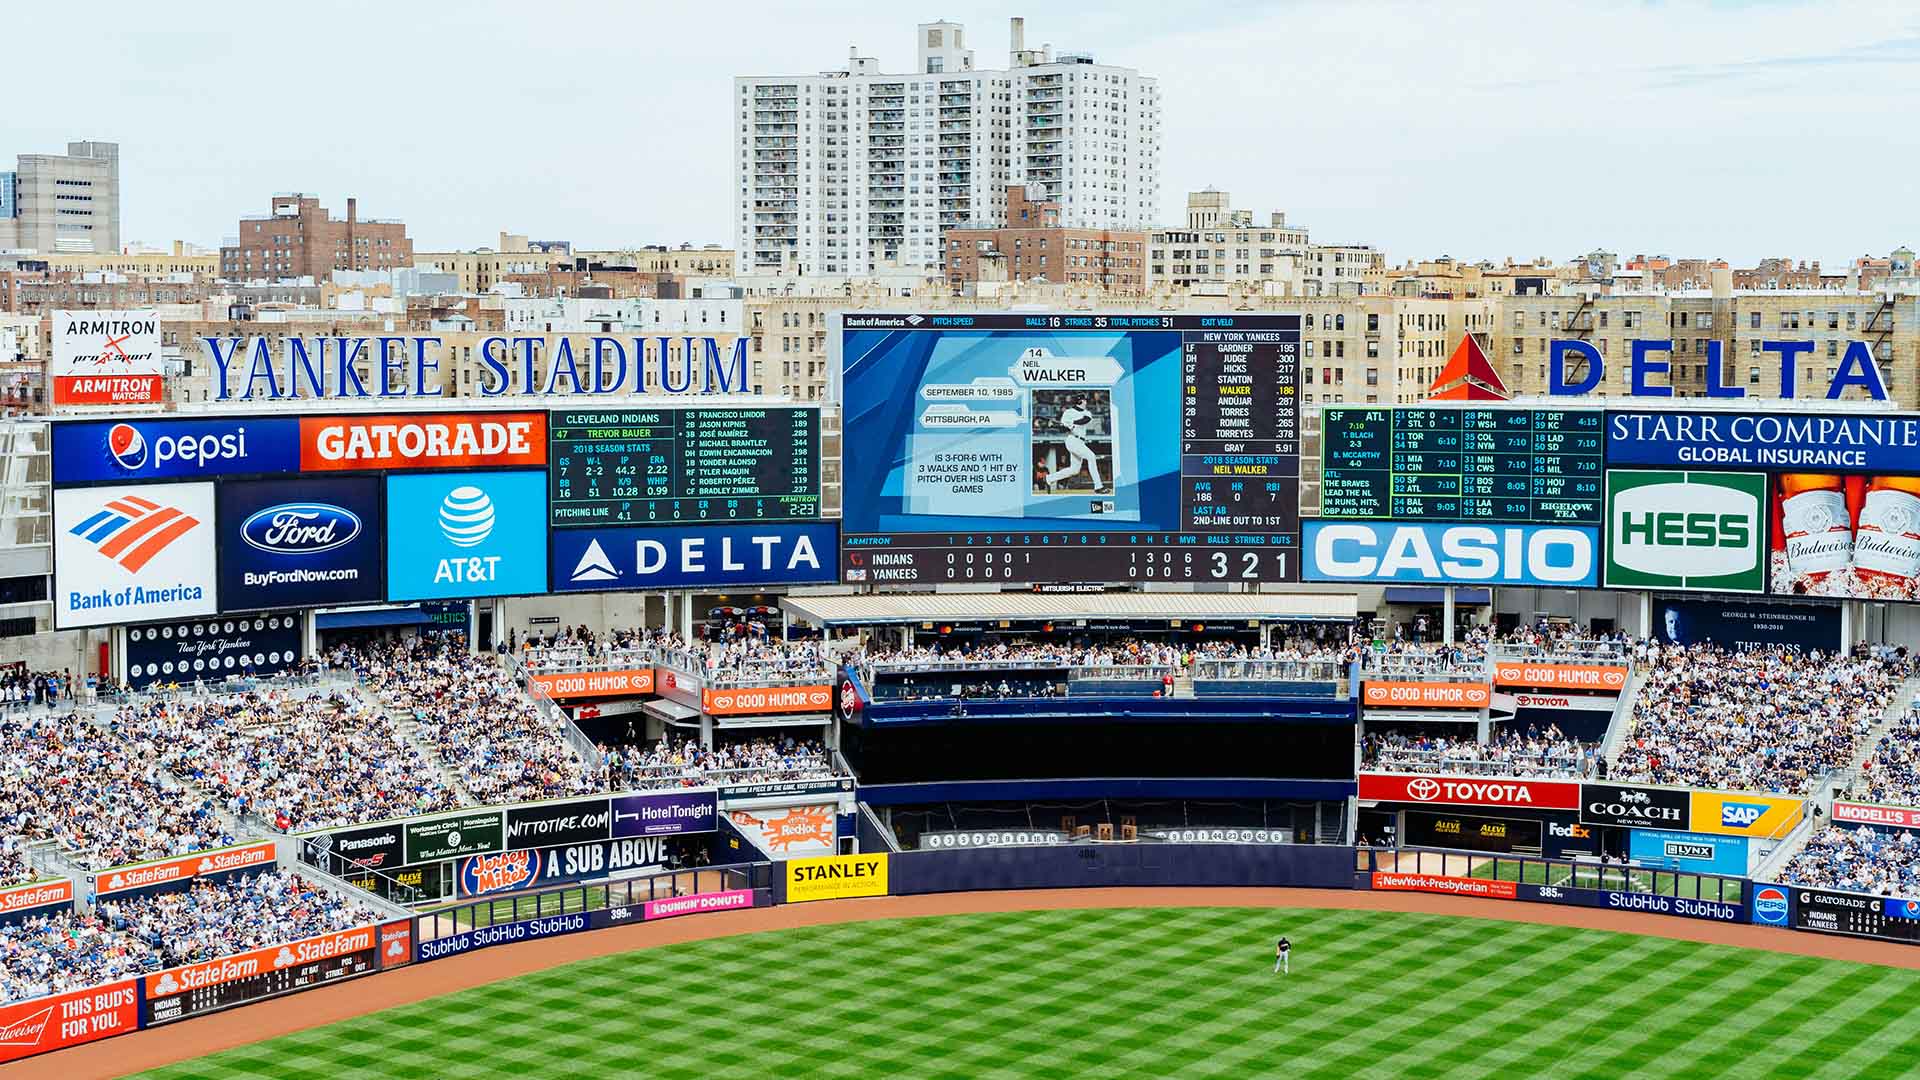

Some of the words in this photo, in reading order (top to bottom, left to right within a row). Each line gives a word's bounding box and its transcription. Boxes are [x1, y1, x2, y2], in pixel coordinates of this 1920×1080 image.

[67, 320, 155, 336] ARMITRON
[1026, 318, 1046, 327] BALLS
[1049, 317, 1060, 328] 16
[1065, 318, 1092, 327] STRIKES
[1095, 317, 1107, 328] 35
[1204, 333, 1221, 341] NEW
[1223, 333, 1244, 341] YORK
[1246, 333, 1280, 341] YANKEES
[1028, 349, 1042, 358] 14
[1218, 344, 1253, 353] GARDNER
[1023, 360, 1040, 368] NEIL
[1223, 355, 1247, 363] JUDGE
[202, 336, 442, 399] YANKEE
[481, 336, 752, 396] STADIUM
[1223, 365, 1247, 373] HICKS
[1549, 340, 1889, 400] DELTA
[1023, 370, 1085, 382] WALKER
[1218, 375, 1253, 384] STANTON
[72, 379, 151, 394] ARMITRON
[926, 388, 975, 397] SEPTEMBER
[992, 388, 1013, 397] 1985
[1220, 386, 1251, 395] WALKER
[112, 391, 151, 401] WATCHES
[566, 414, 618, 424] CLEVELAND
[622, 413, 659, 423] INDIANS
[699, 411, 738, 419] FRANCISCO
[925, 415, 978, 424] PITTSBURGH,
[979, 415, 991, 423] PA
[1220, 408, 1249, 417] TORRES
[1330, 412, 1344, 421] SF
[1365, 412, 1384, 421] ATL
[587, 429, 619, 438] TREVOR
[622, 428, 651, 437] BAUER
[1612, 414, 1725, 442] STARR
[1731, 416, 1918, 447] COMPANIE
[155, 428, 248, 468] pepsi
[317, 421, 532, 461] GATORADE
[699, 439, 729, 447] MICHAEL
[731, 439, 767, 447] BRANTLEY
[1678, 447, 1752, 463] GLOBAL
[1757, 448, 1865, 466] INSURANCE
[919, 465, 925, 473] 3
[927, 465, 958, 473] WALKS
[960, 465, 980, 473] AND
[990, 465, 1003, 473] HIT
[1006, 465, 1017, 473] BY
[917, 475, 942, 483] PITCH
[944, 475, 966, 483] OVER
[969, 475, 984, 483] HIS
[986, 475, 1007, 483] LAST
[1010, 475, 1016, 483] 3
[1325, 479, 1340, 487] THE
[1341, 479, 1369, 488] BRAVES
[1477, 477, 1494, 485] BOS
[952, 485, 983, 494] GAMES
[1361, 489, 1372, 497] NL
[1476, 485, 1492, 494] TEX
[265, 511, 336, 545] Ford
[1622, 511, 1748, 548] HESS
[636, 535, 820, 574] DELTA
[872, 554, 913, 565] INDIANS
[1315, 525, 1591, 582] CASIO
[434, 556, 501, 584] AT&T
[1211, 552, 1228, 578] 3
[1242, 552, 1258, 578] 2
[1276, 552, 1286, 579] 1
[244, 568, 359, 587] BuyFordNow.com
[872, 568, 918, 579] YANKEES
[70, 590, 112, 611] Bank
[115, 588, 131, 607] of
[132, 584, 202, 606] America
[177, 641, 197, 653] New
[197, 640, 216, 656] York
[218, 637, 251, 655] Yankees
[1524, 668, 1555, 682] GOOD
[1559, 669, 1599, 684] HUMOR
[556, 678, 585, 693] GOOD
[589, 675, 629, 691] HUMOR
[736, 693, 764, 708] GOOD
[769, 691, 807, 707] HUMOR
[1391, 687, 1420, 700] GOOD
[1424, 688, 1463, 701] HUMOR
[1532, 697, 1569, 707] TOYOTA
[1443, 782, 1532, 802] TOYOTA
[642, 804, 713, 820] HotelTonight
[1589, 802, 1680, 820] COACH
[1722, 806, 1760, 824] SAP
[1839, 806, 1904, 823] MODELL'S
[507, 811, 609, 838] NITTOTIRE.COM
[781, 825, 817, 836] RedHot
[1549, 823, 1590, 839] FedEx
[340, 833, 396, 851] Panasonic
[547, 858, 560, 878] A
[566, 846, 603, 874] SUB
[609, 836, 668, 868] ABOVE
[1678, 844, 1709, 856] LYNX
[794, 862, 879, 882] STANLEY
[1384, 875, 1488, 893] NewYork-Presbyterian
[660, 900, 699, 914] DUNKIN'
[702, 894, 744, 907] DONUTS
[1610, 893, 1669, 912] StubHub
[1675, 900, 1734, 920] StubHub
[1756, 900, 1787, 910] PEPSI
[1815, 896, 1865, 909] GATORADE
[1809, 911, 1837, 921] INDIANS
[530, 916, 584, 935] StubHub
[1807, 919, 1838, 930] YANKEES
[473, 924, 525, 947] StubHub
[421, 936, 470, 959] StubHub
[61, 997, 92, 1019] THIS
[95, 988, 135, 1011] BUD'S
[154, 996, 181, 1011] INDIANS
[154, 1006, 182, 1021] YANKEES
[62, 1020, 88, 1040] FOR
[90, 1011, 121, 1033] YOU.
